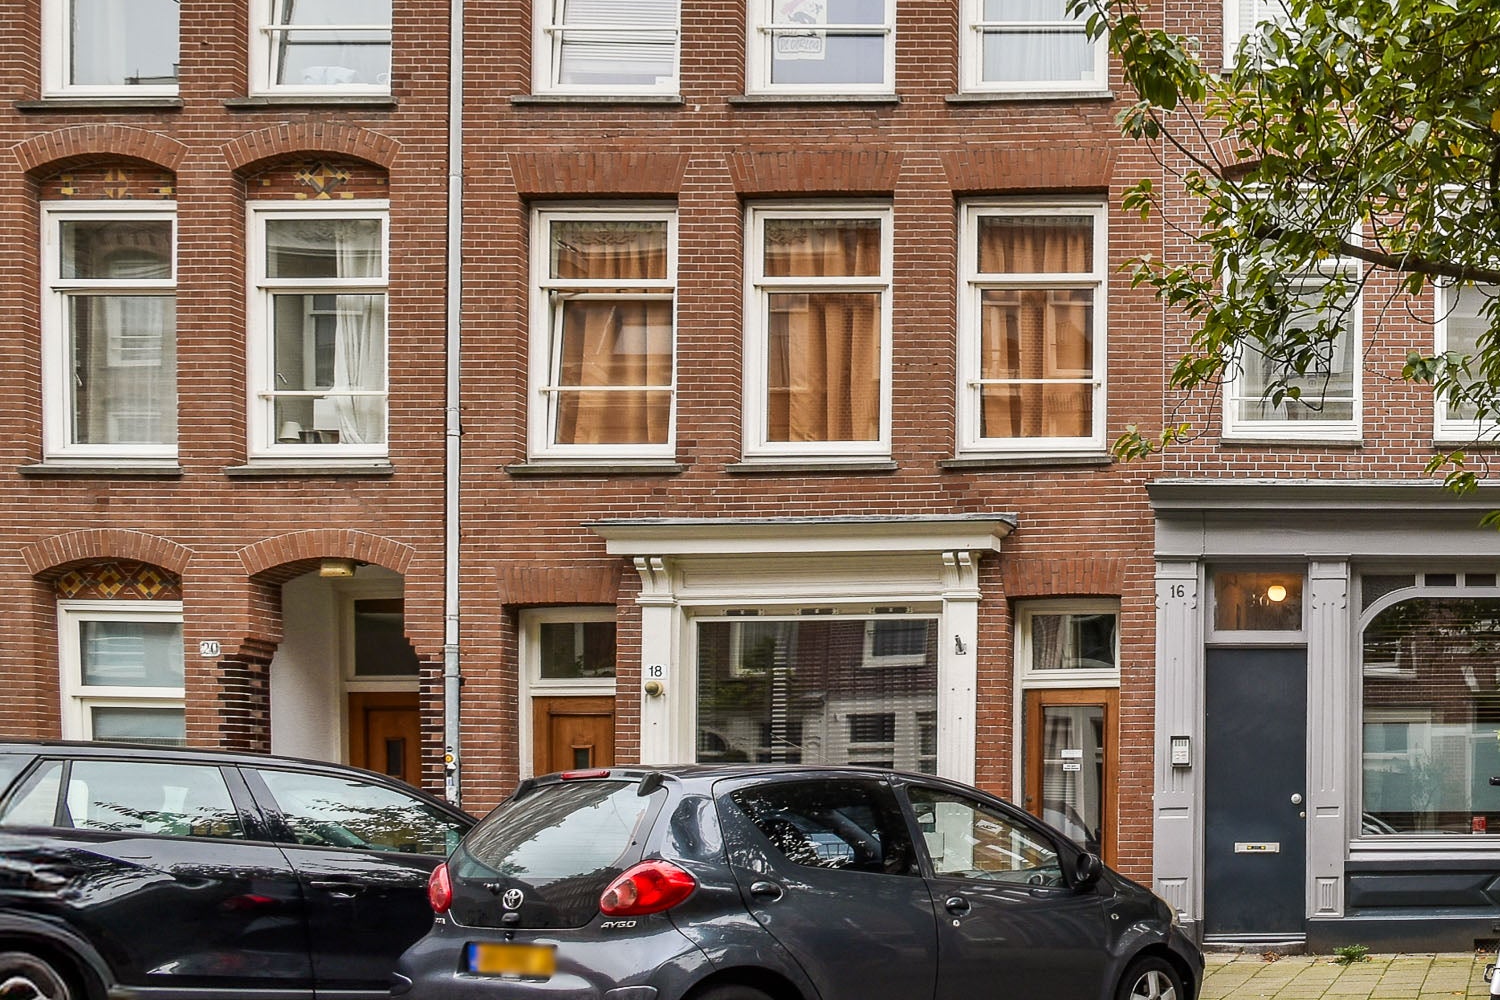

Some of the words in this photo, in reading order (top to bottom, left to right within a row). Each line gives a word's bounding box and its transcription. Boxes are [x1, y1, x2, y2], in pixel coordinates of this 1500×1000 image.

[1170, 584, 1185, 598] 16
[201, 642, 219, 655] 20
[648, 665, 663, 677] 18
[600, 920, 637, 929] AYGO
